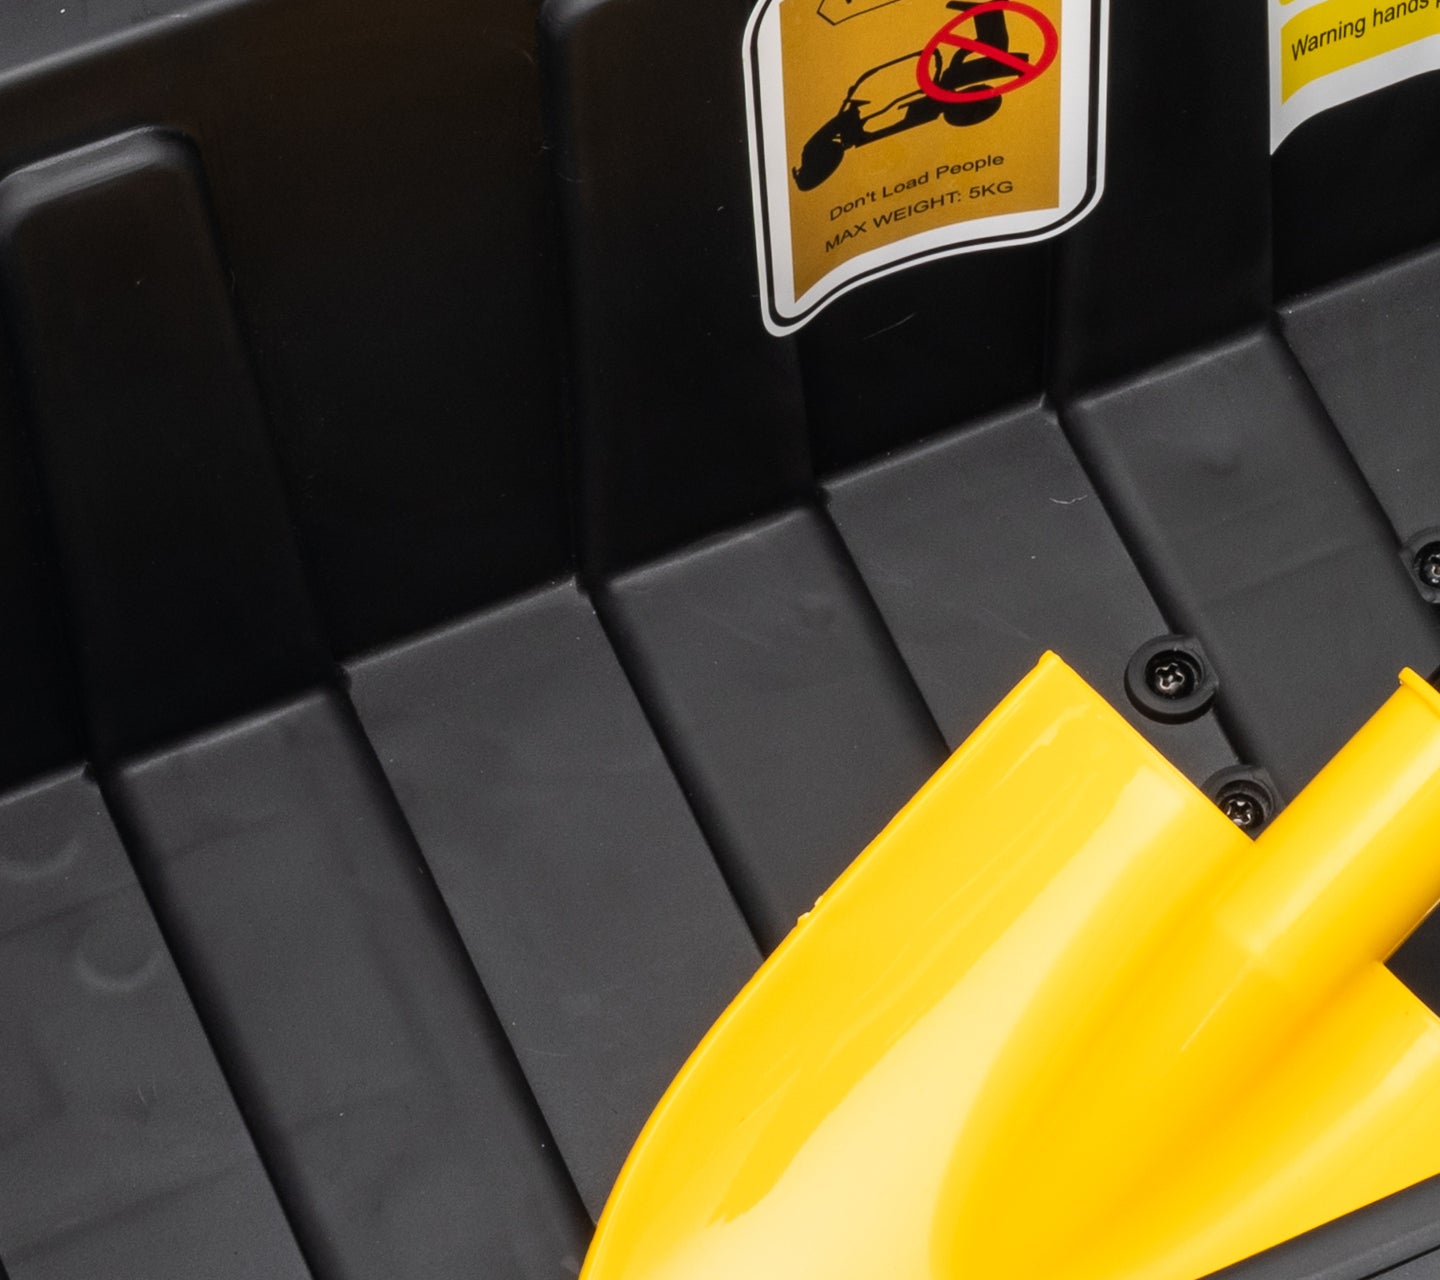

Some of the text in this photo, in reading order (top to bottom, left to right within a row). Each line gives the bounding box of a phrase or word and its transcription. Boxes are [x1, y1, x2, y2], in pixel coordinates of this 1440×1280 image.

[1292, 17, 1365, 61] Warning
[824, 180, 1014, 253] MAX WEIGHT: 5KG
[829, 154, 1004, 221] Don't Load People
